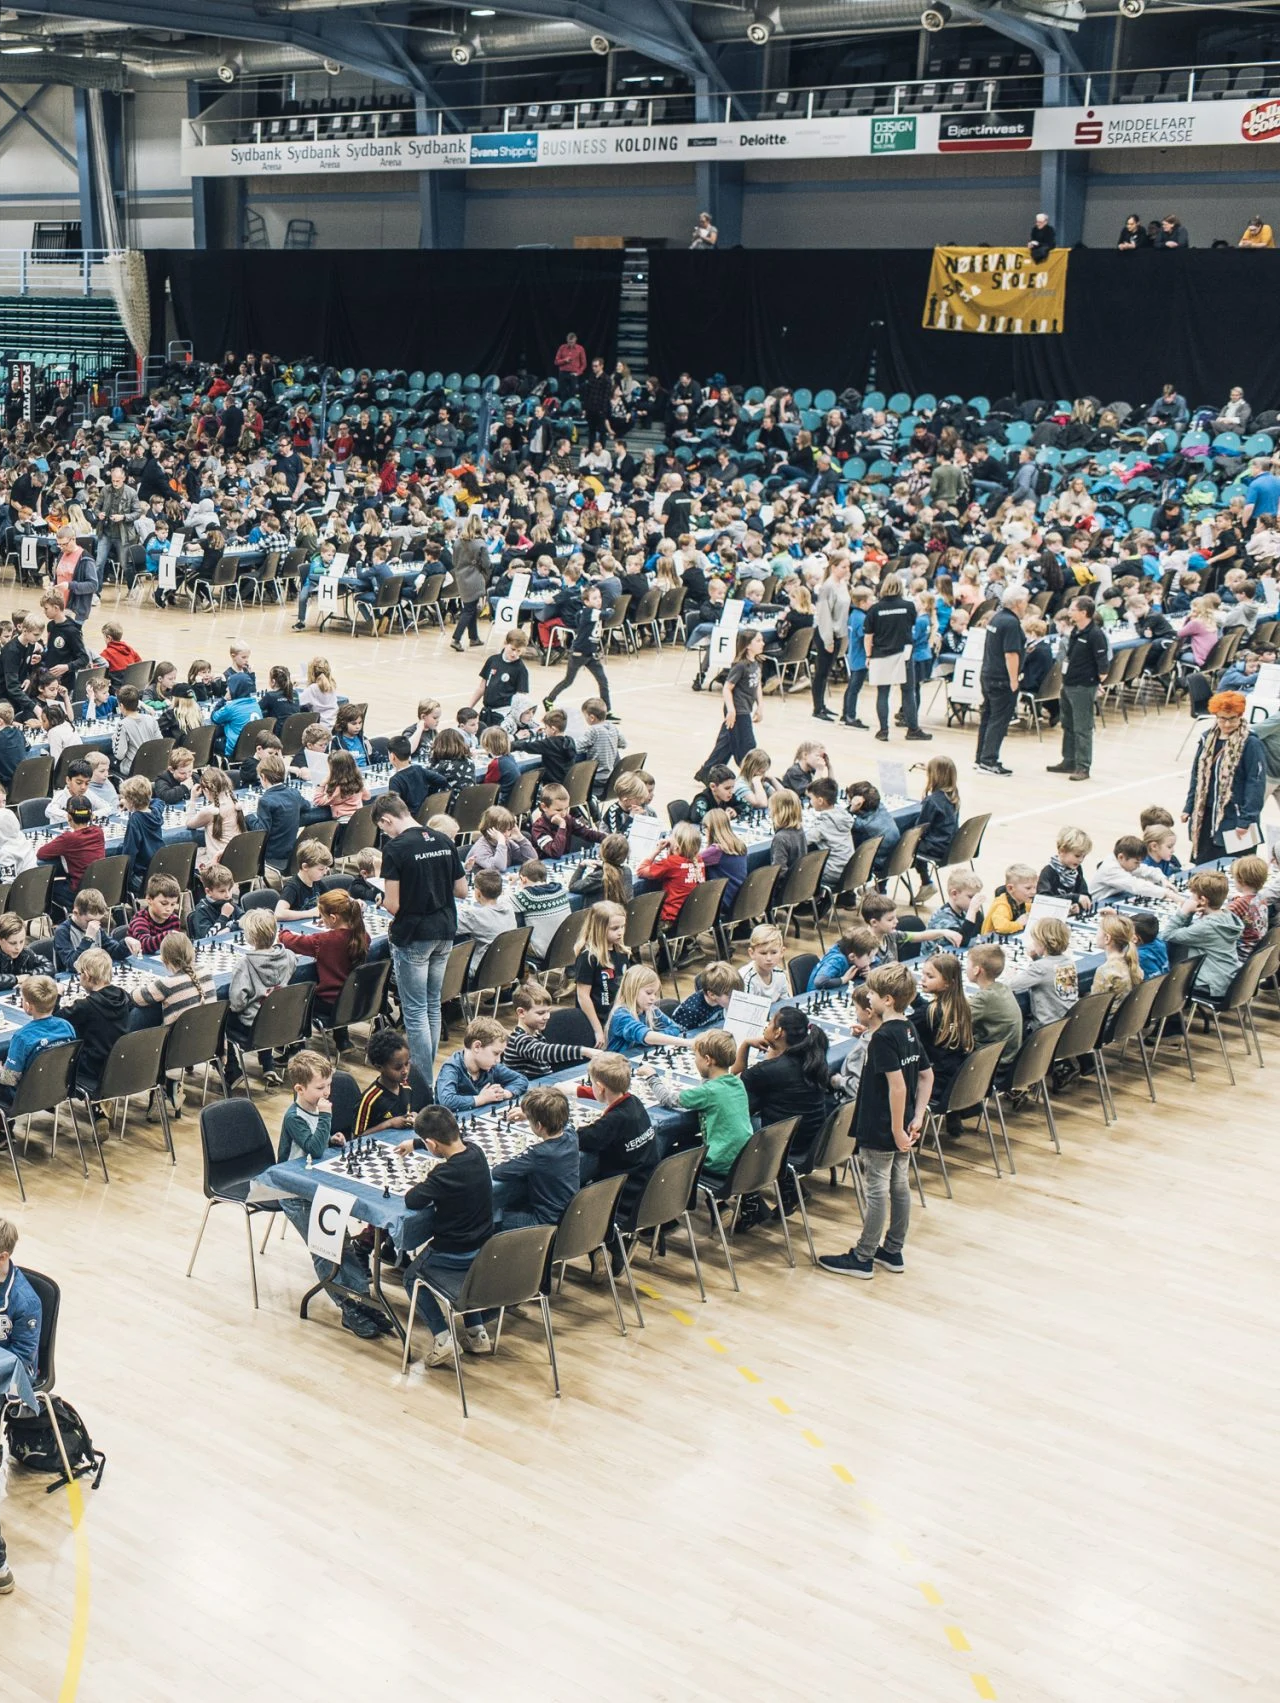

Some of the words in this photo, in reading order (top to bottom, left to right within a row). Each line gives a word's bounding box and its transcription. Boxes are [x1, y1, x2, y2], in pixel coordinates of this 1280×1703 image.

[947, 124, 1024, 137] Bjertinvest
[1109, 117, 1196, 131] MIDDELFART
[873, 133, 896, 144] CITY
[1107, 130, 1193, 144] SPAREKASSE
[346, 142, 402, 160] Sydbank
[408, 139, 466, 158] Sydbank
[499, 145, 537, 159] Shipping
[543, 139, 607, 155] BUSINESS
[615, 136, 678, 152] KOLDING
[231, 148, 281, 164] Sydbank
[287, 146, 340, 163] Sydbank
[380, 158, 402, 167] Arena
[443, 156, 466, 165] Arena
[262, 162, 282, 171] Arena
[320, 160, 340, 169] Arena
[991, 272, 1049, 290] SKOLEN
[25, 544, 30, 561] J
[322, 584, 333, 599] H
[501, 606, 512, 622] G
[719, 636, 729, 653] F
[962, 669, 975, 688] E
[1250, 705, 1269, 724] D
[317, 1204, 342, 1235] C
